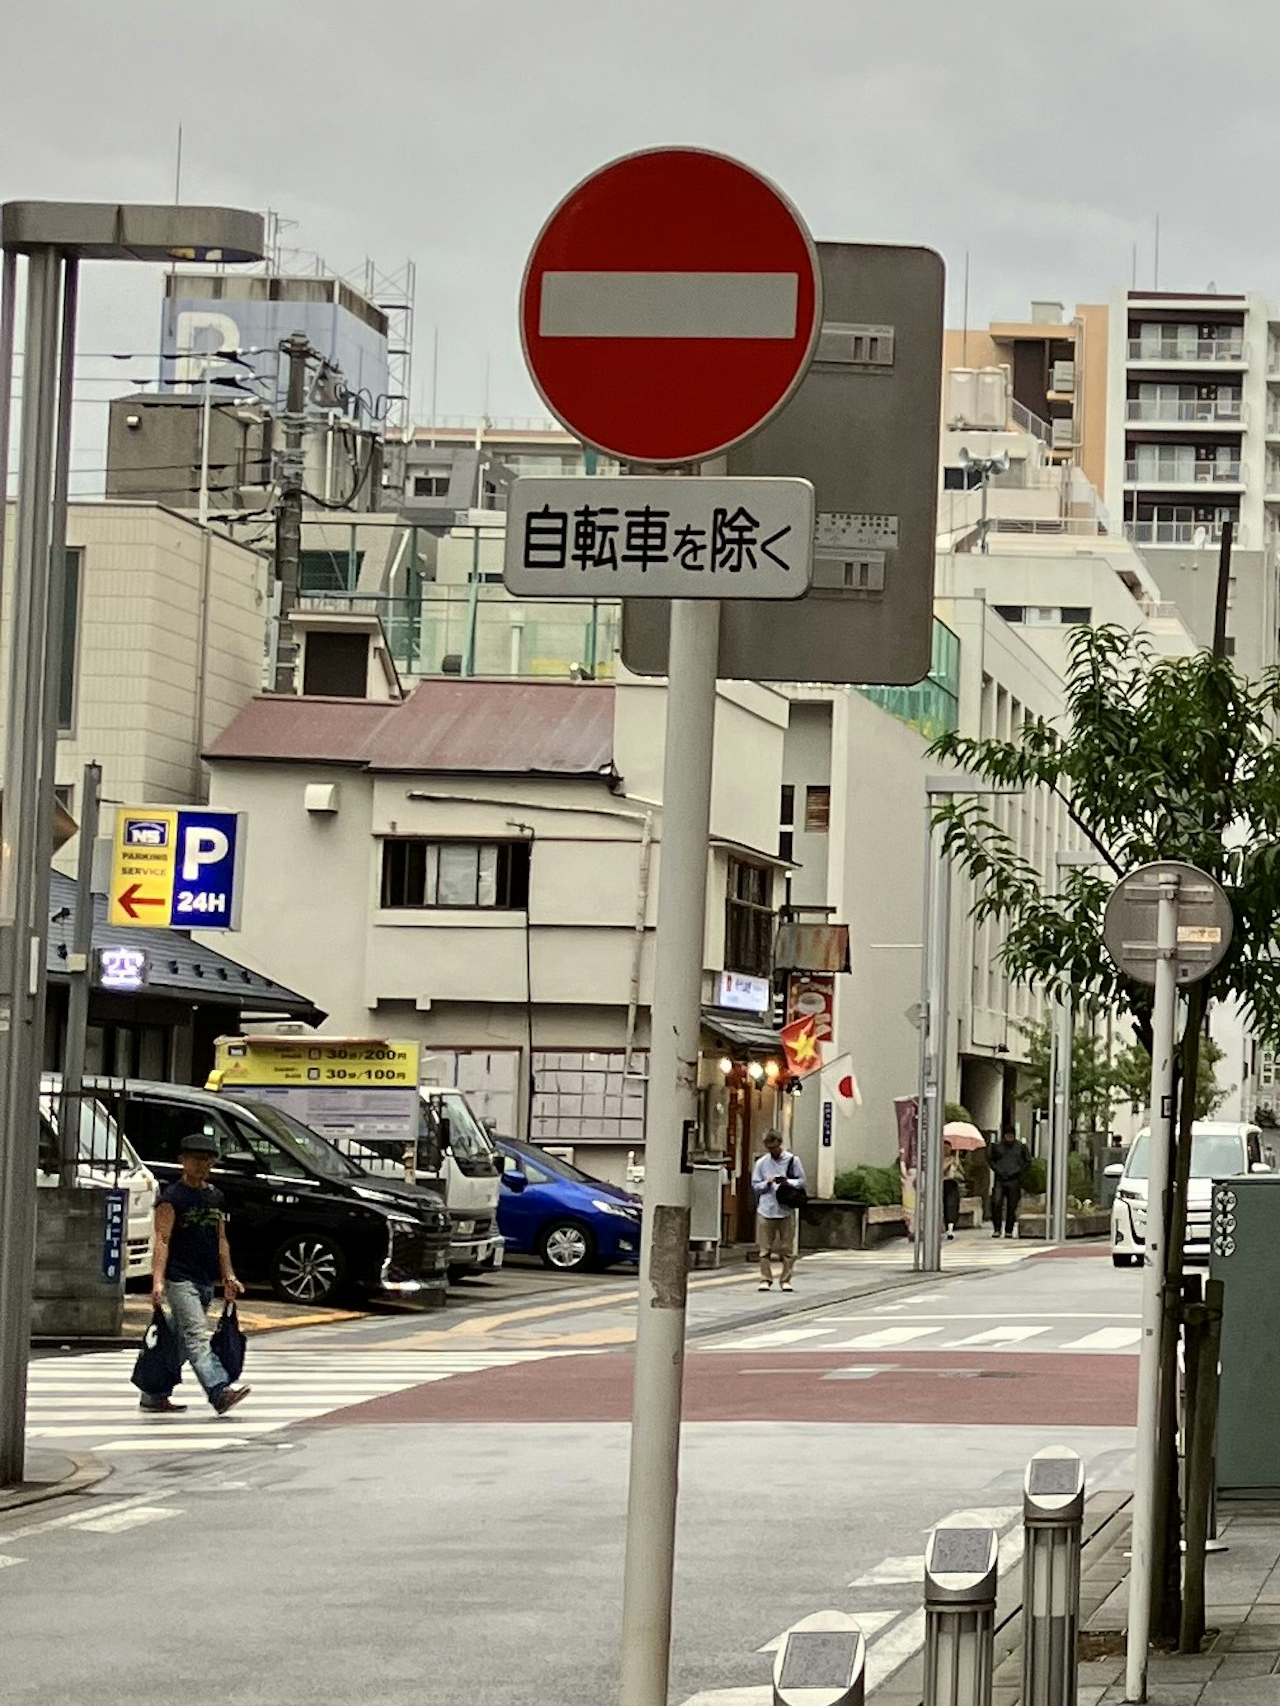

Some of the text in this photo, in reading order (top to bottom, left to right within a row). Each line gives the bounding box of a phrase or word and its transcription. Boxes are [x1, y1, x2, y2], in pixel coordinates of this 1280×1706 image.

[522, 505, 793, 575] 自転車を除く
[122, 852, 168, 861] PARKING
[182, 826, 229, 881] P
[121, 866, 167, 876] SERVICE
[177, 890, 226, 913] 24H
